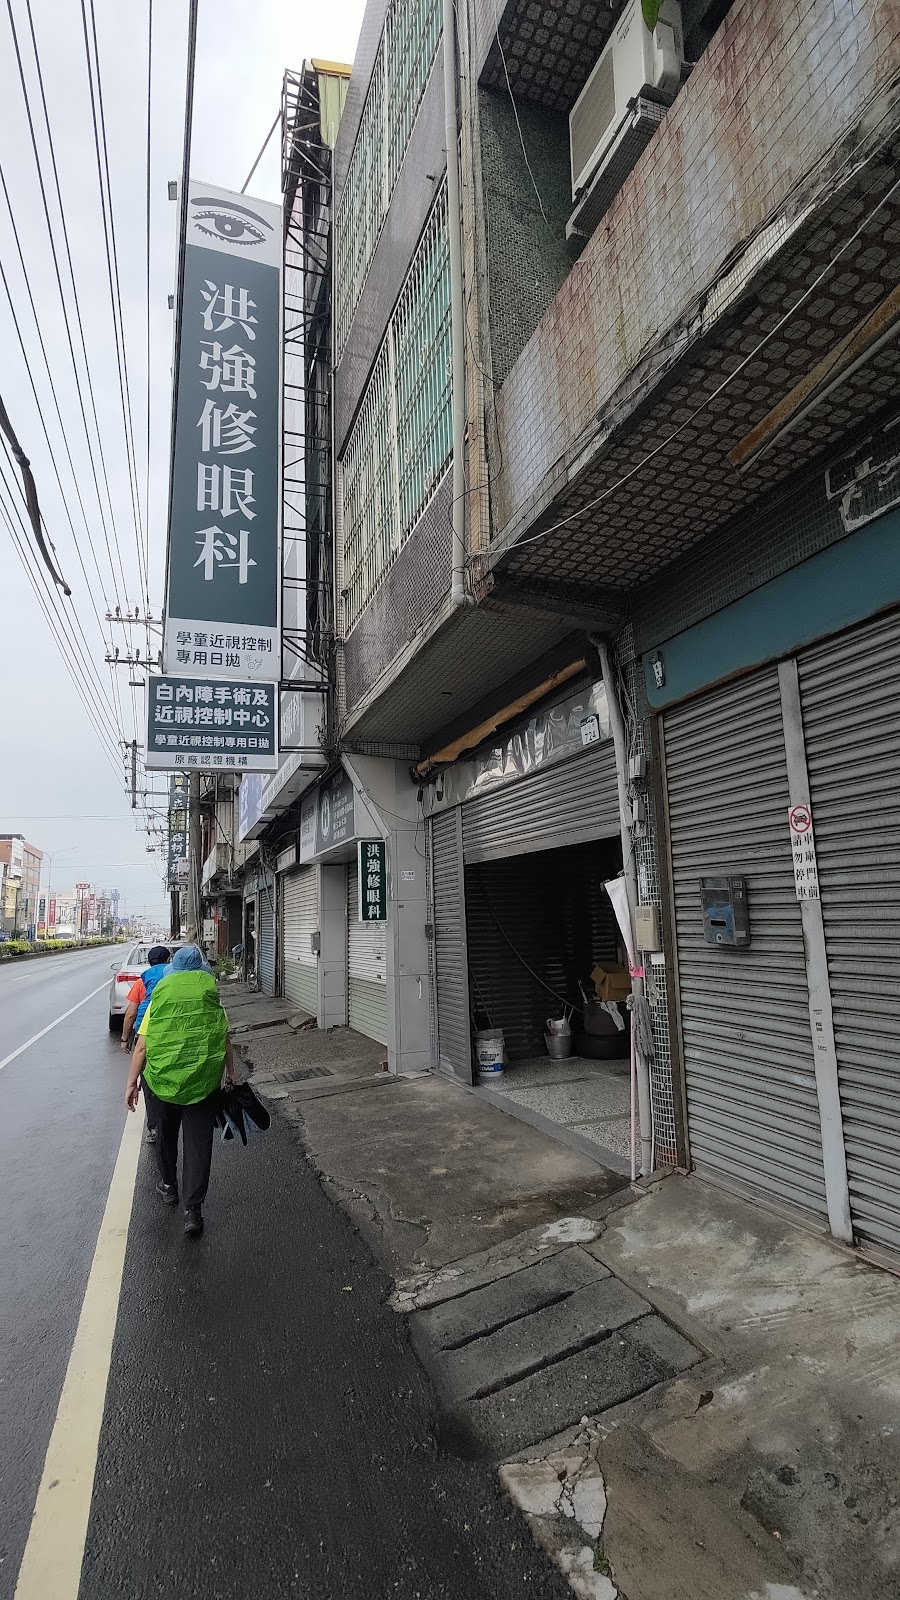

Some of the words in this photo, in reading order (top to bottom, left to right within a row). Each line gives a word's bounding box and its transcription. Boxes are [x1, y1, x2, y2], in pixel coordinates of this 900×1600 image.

[193, 279, 258, 584] 洪強修眼科
[176, 631, 272, 653] 學童近視控制
[155, 705, 270, 727] 近視控制中心
[156, 683, 269, 706] 白內障手術及
[175, 755, 248, 766] 原廠認證機構
[367, 844, 381, 919] 洪強修眼科
[793, 834, 807, 899] 請勿停車
[804, 833, 818, 898] 車庫門前
